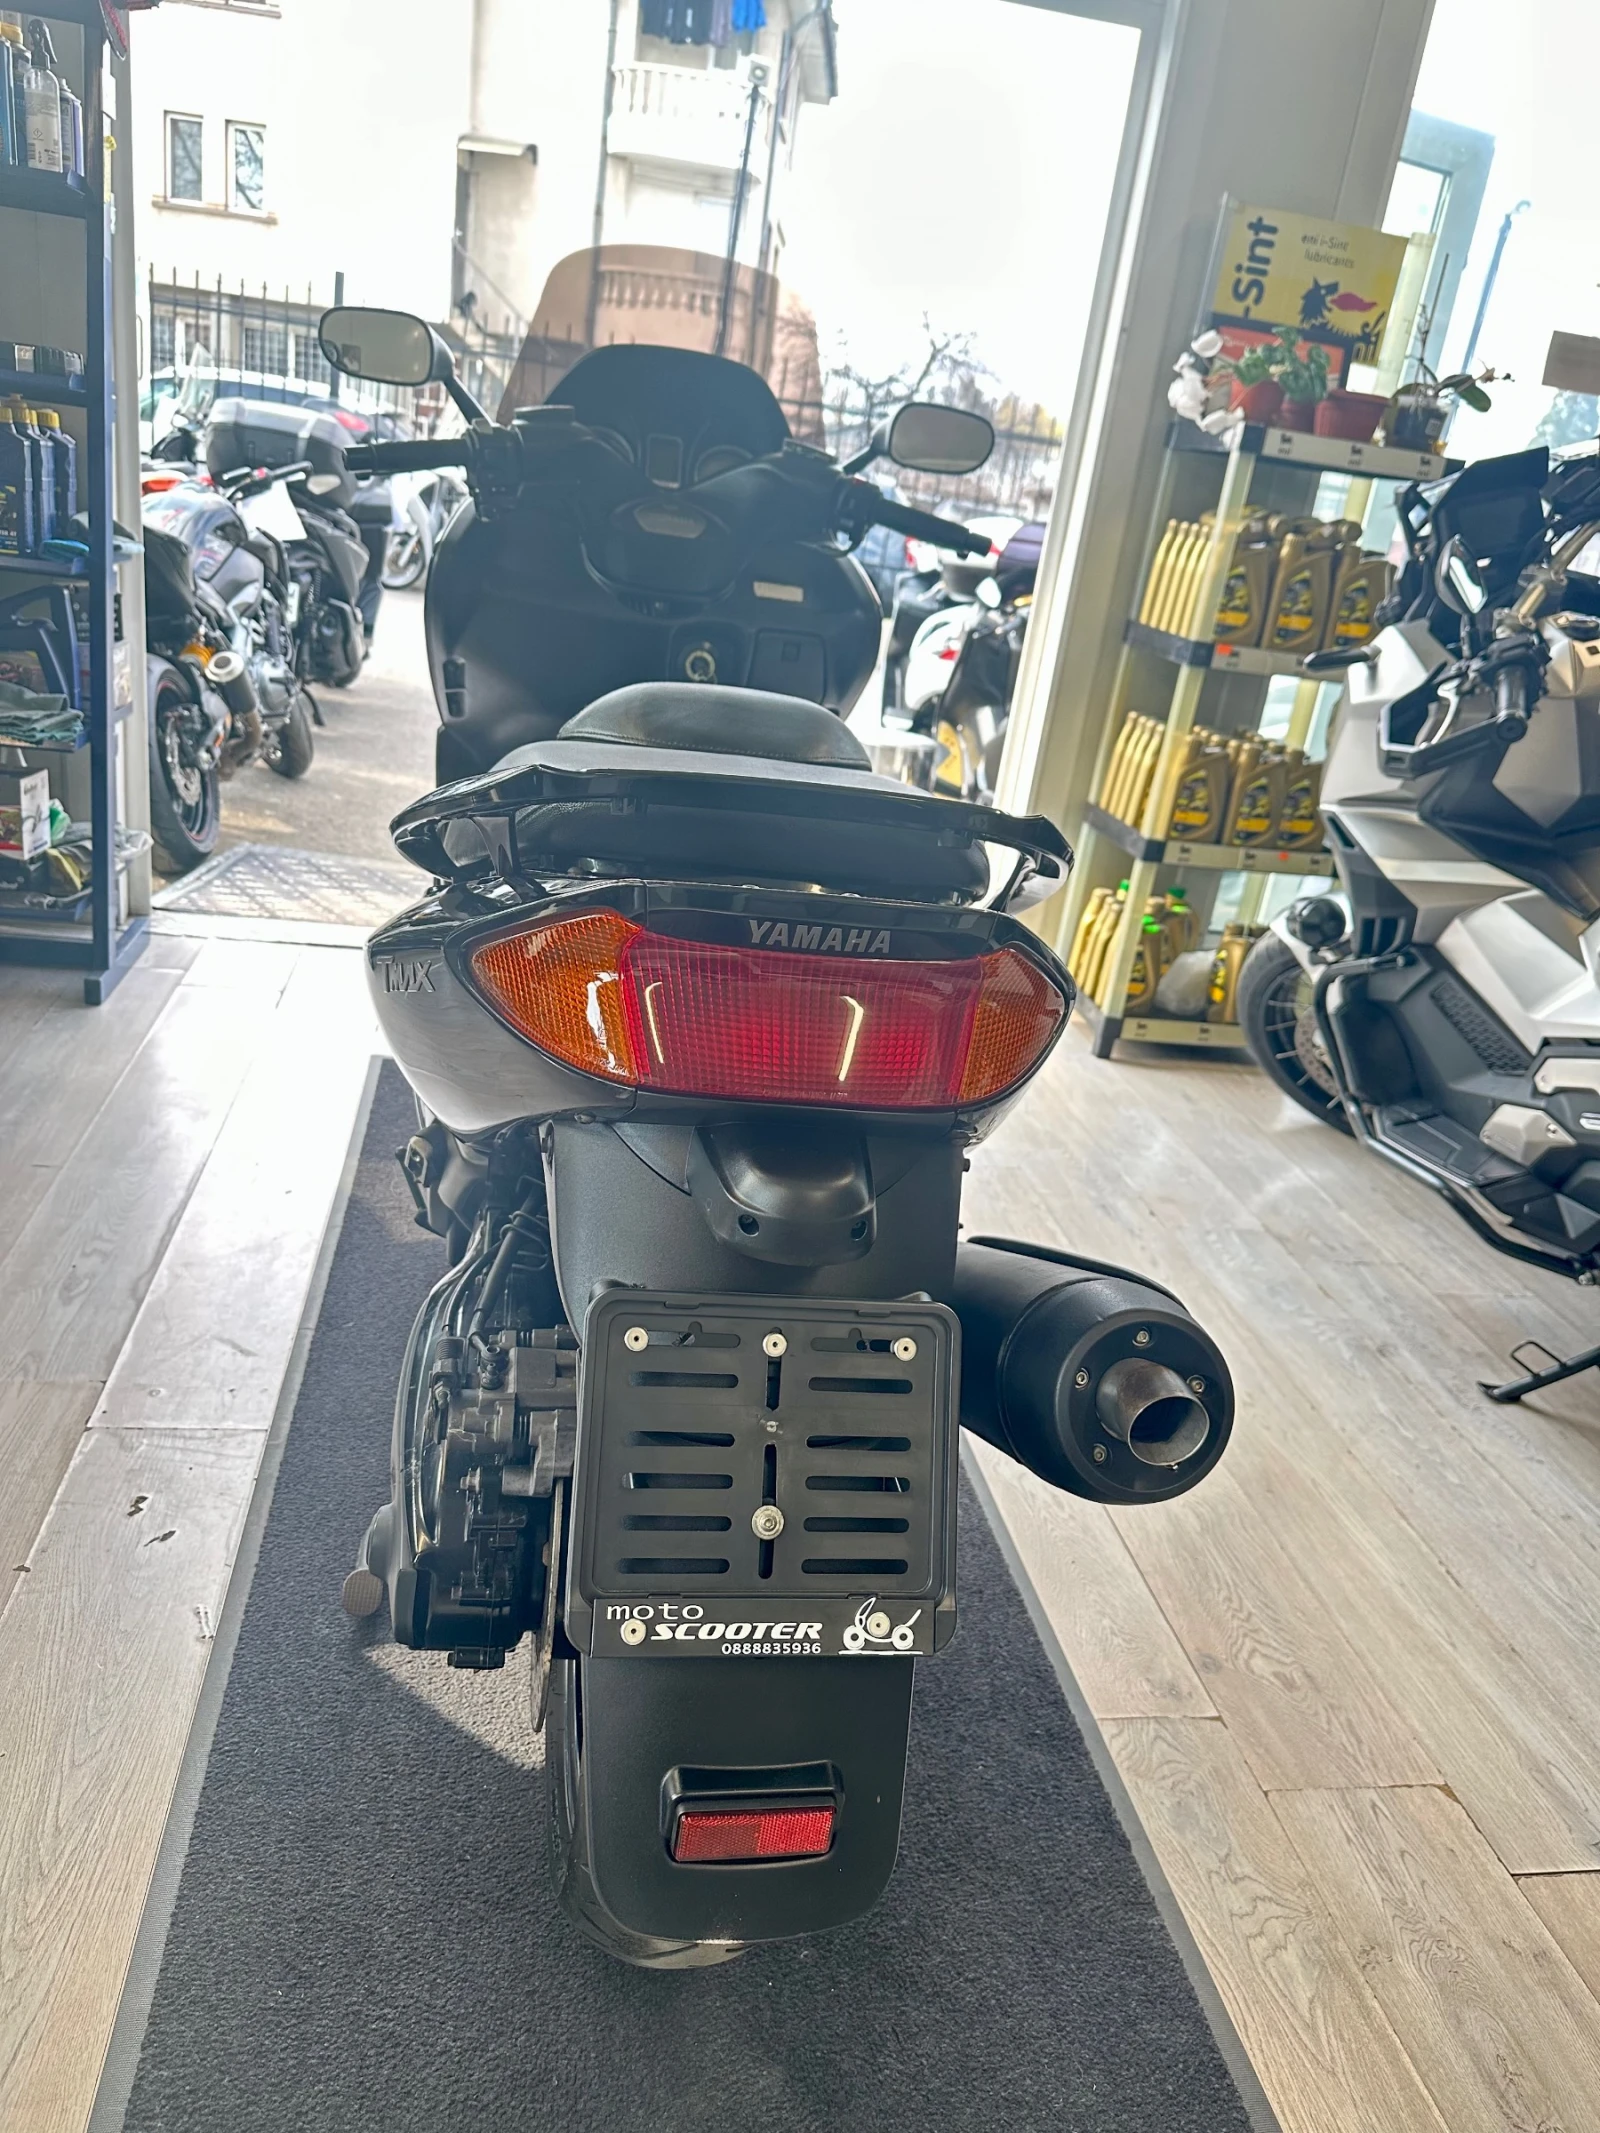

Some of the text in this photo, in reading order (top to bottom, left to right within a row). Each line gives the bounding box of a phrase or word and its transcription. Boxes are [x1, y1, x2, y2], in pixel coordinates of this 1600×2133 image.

[749, 919, 891, 954] YAMAHA
[607, 1602, 704, 1620] moto
[650, 1622, 823, 1641] SCOOTER
[721, 1642, 822, 1655] 0888835936
